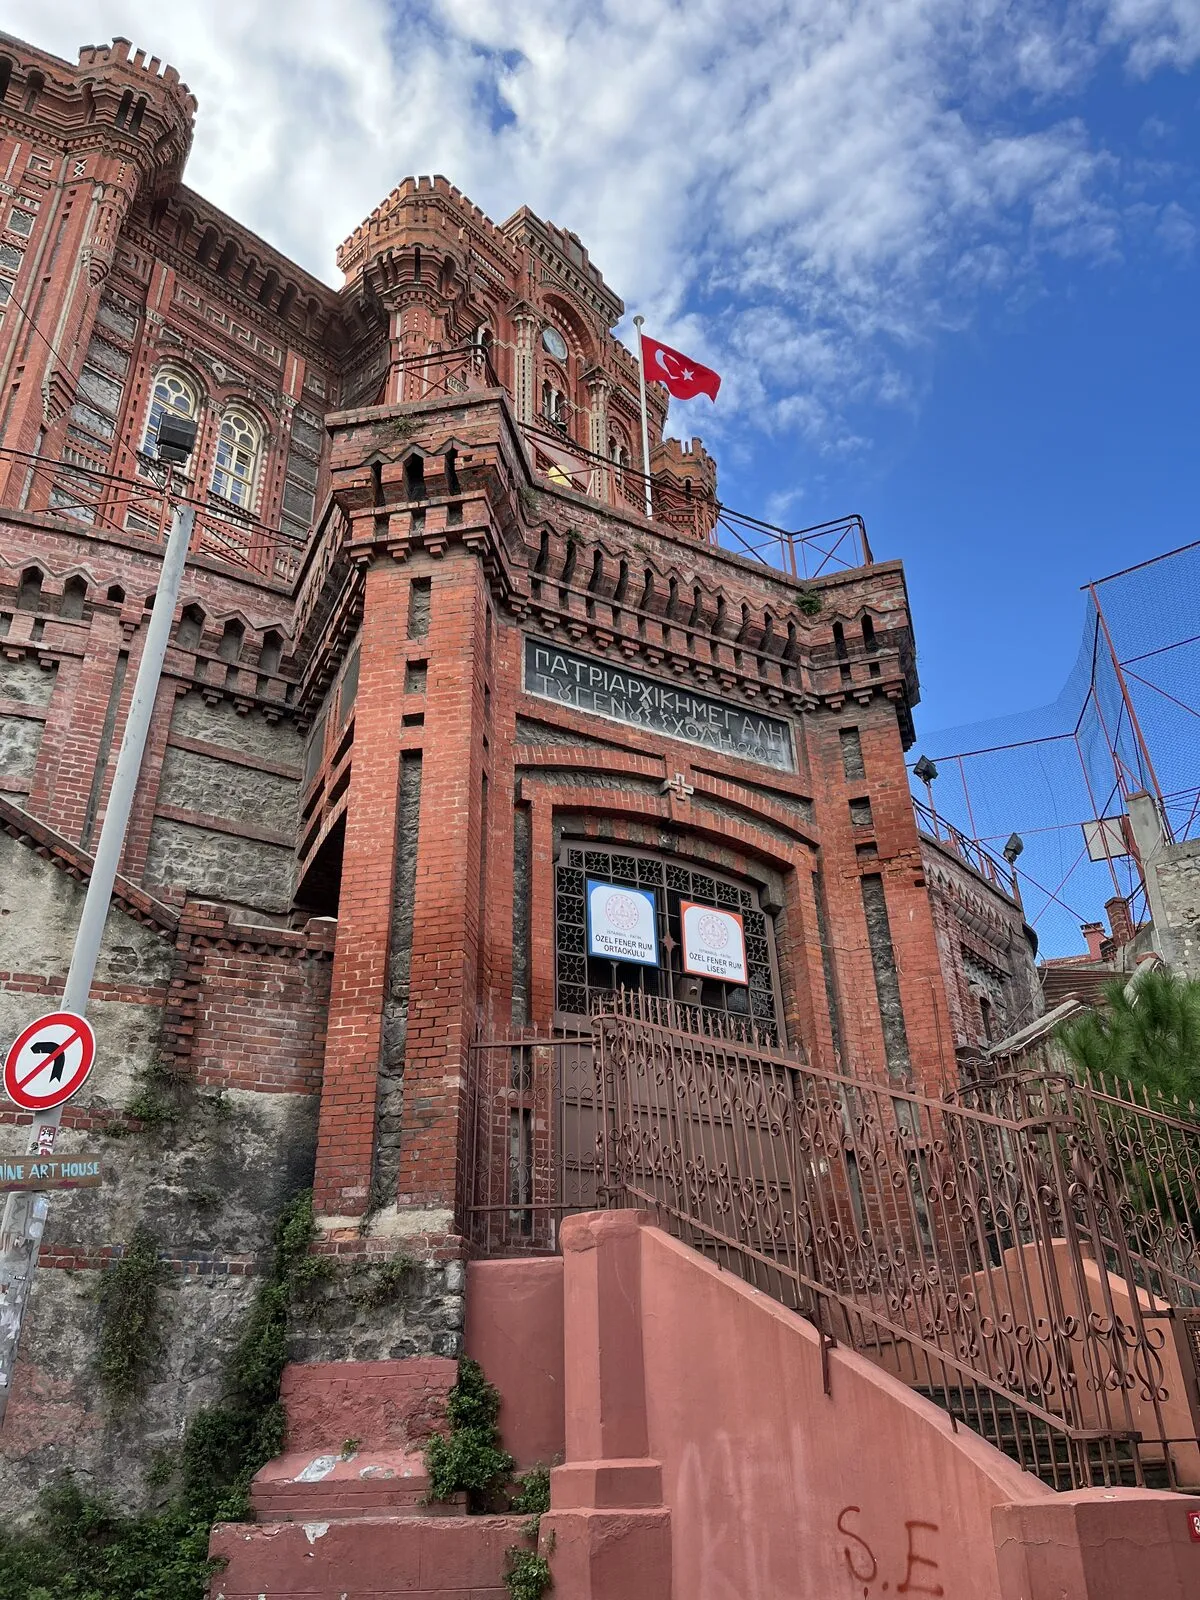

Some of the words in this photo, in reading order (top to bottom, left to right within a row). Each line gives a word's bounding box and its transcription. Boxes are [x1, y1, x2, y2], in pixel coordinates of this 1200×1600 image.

[615, 937, 637, 948] FENER
[638, 942, 653, 950] RUM
[604, 944, 645, 958] ORTAOKULU
[707, 956, 727, 967] FENER
[728, 961, 742, 969] RUM
[28, 1162, 59, 1179] ART
[61, 1161, 101, 1178] HOUSE
